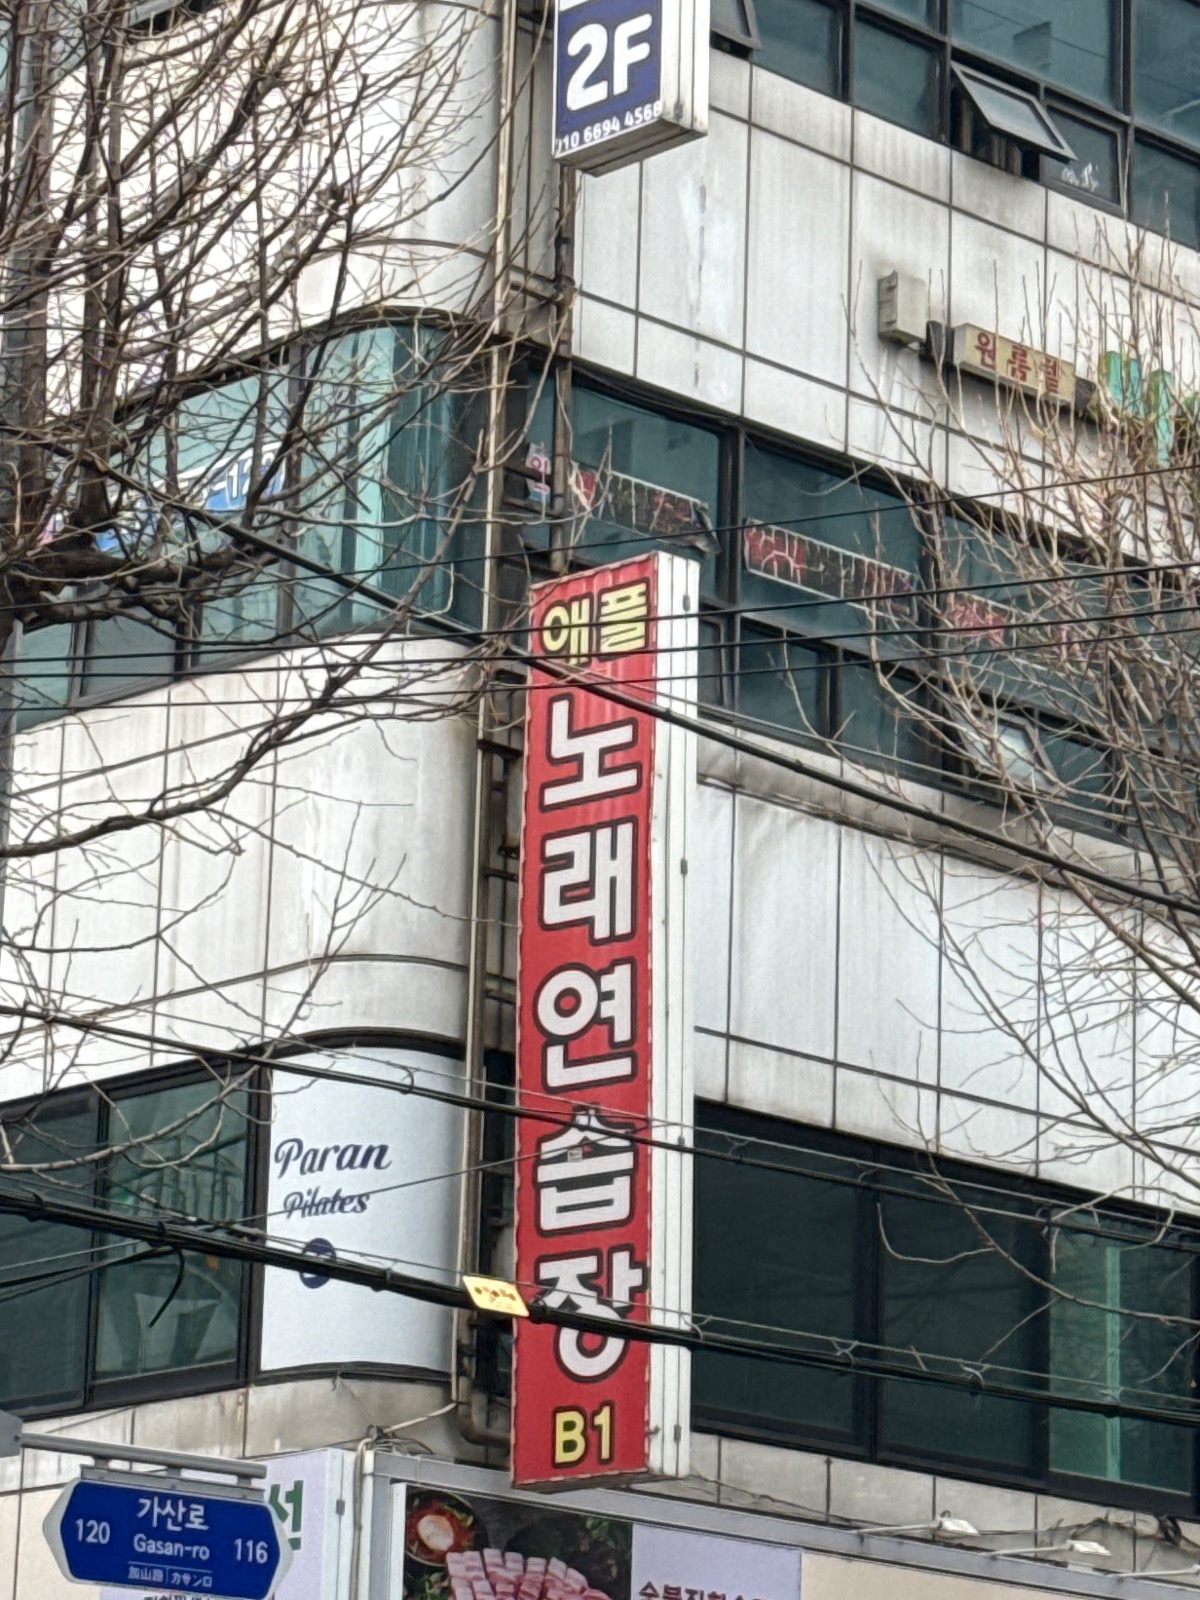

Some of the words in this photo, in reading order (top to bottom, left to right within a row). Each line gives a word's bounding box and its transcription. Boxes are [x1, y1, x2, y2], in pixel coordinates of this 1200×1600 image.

[566, 13, 653, 111] 2F
[583, 115, 621, 142] 6694
[541, 579, 649, 665] 애플
[534, 693, 645, 1380] 노래연습장
[274, 1137, 392, 1179] Paran
[283, 1185, 370, 1219] Pilates
[554, 1403, 613, 1467] B1
[136, 1496, 210, 1531] 가산로
[75, 1518, 111, 1545] 120
[133, 1532, 211, 1561] Gasan-ro
[233, 1537, 269, 1564] 116
